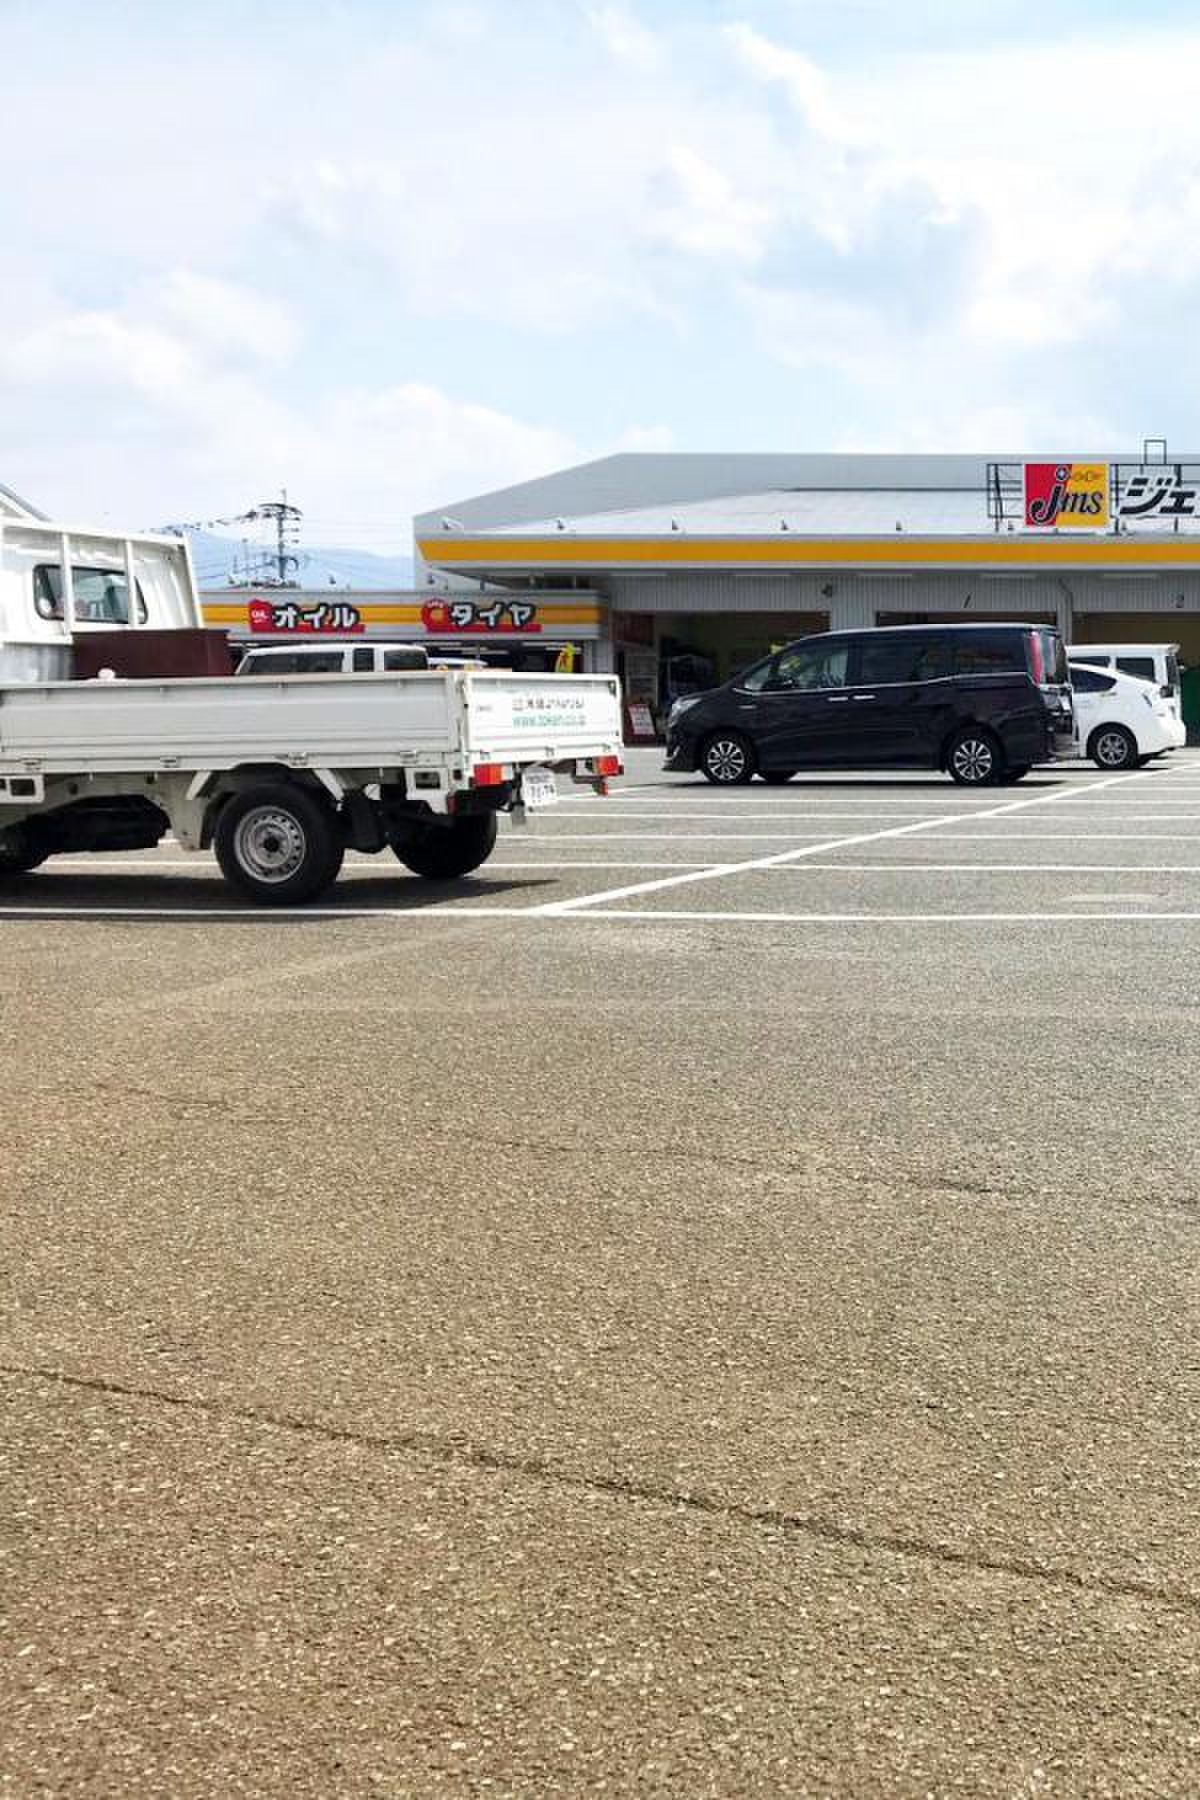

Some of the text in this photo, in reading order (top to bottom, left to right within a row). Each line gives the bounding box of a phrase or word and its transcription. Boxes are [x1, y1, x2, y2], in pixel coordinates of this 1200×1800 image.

[1029, 465, 1104, 526] jms
[273, 604, 358, 630] オイル
[450, 602, 533, 628] タイヤ
